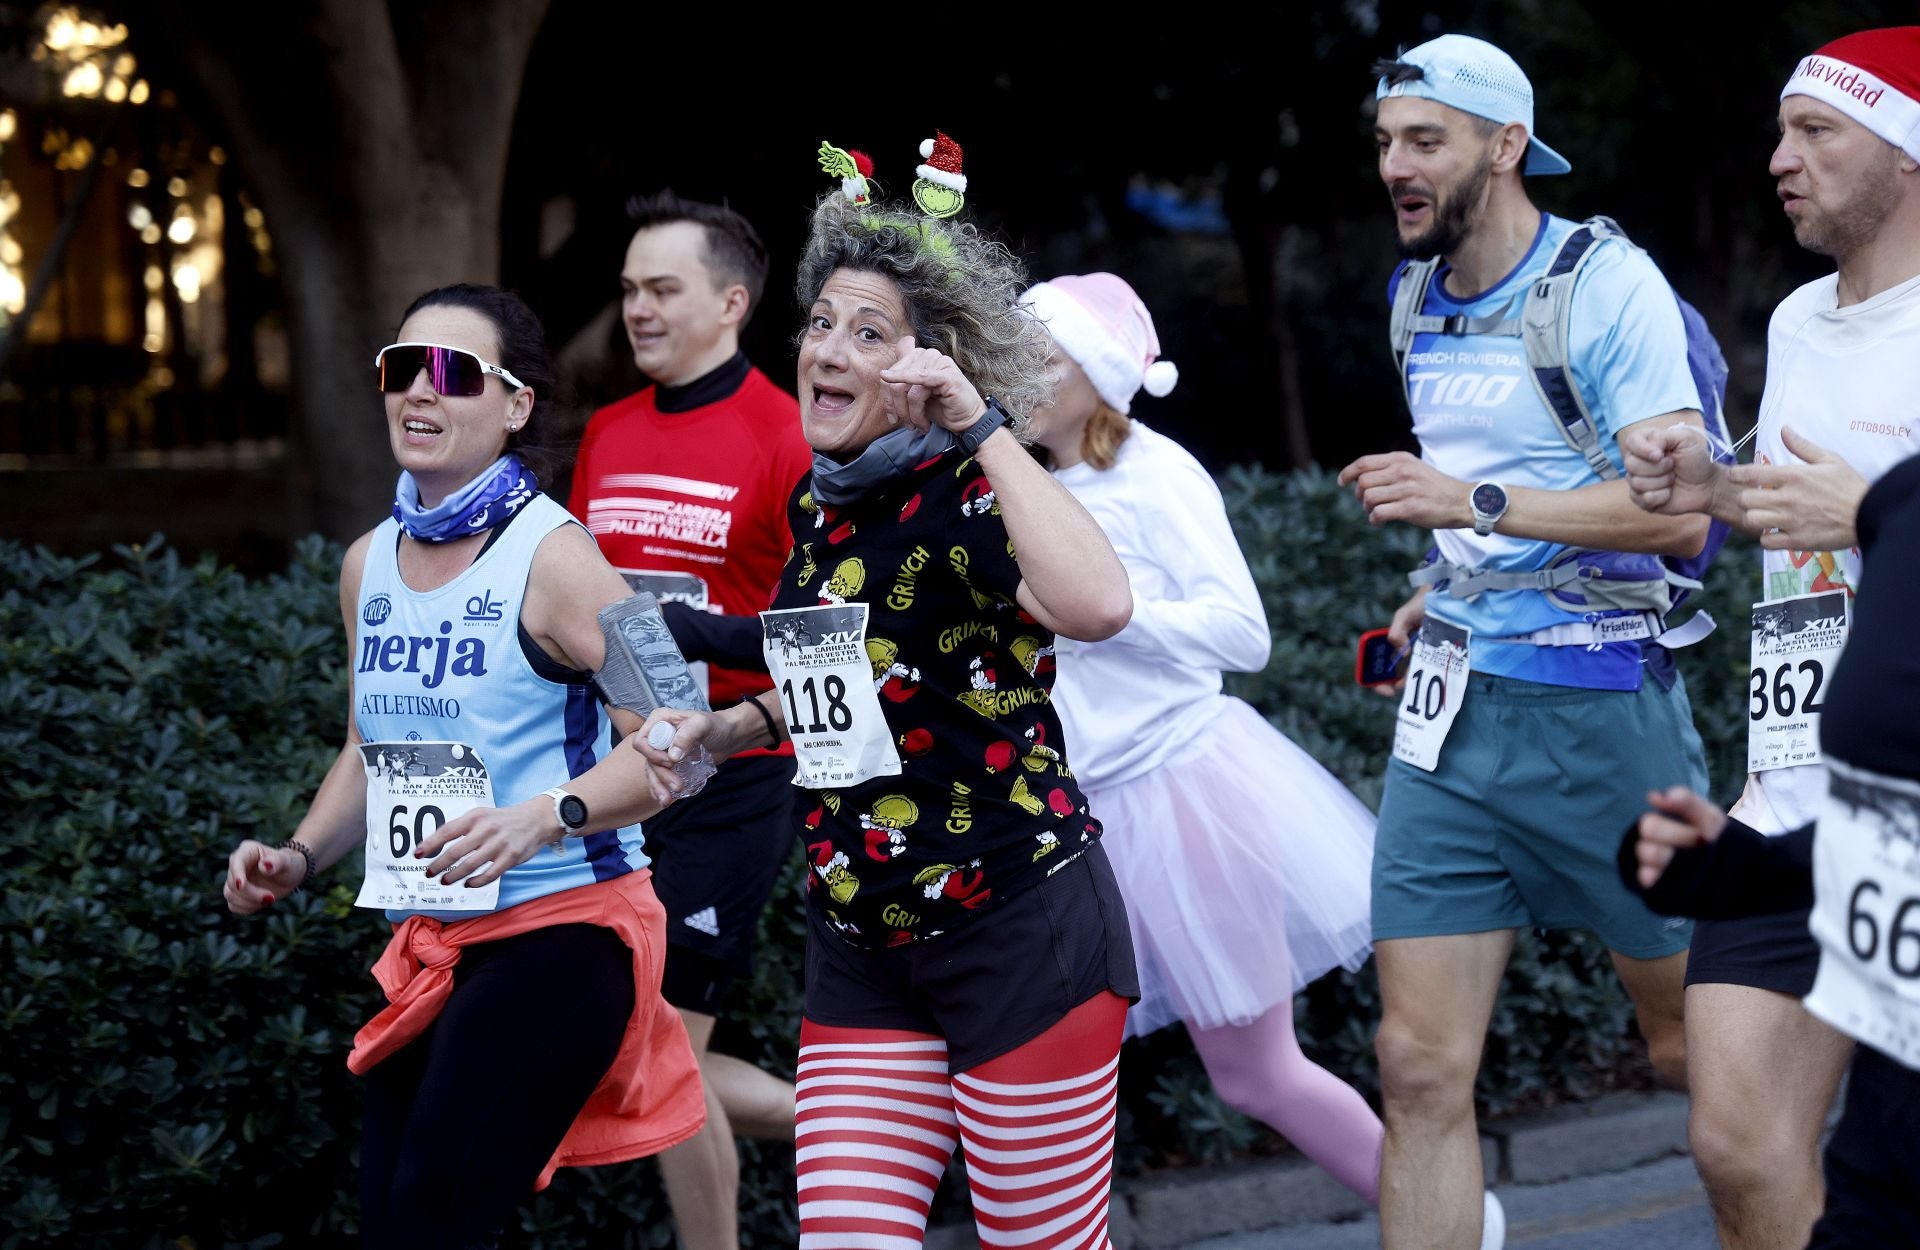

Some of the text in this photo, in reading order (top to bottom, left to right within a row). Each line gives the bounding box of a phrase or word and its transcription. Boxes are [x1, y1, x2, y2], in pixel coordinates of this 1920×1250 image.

[1801, 57, 1885, 108] Navidad
[1409, 351, 1521, 367] FRENCH RIVIERA
[1409, 371, 1521, 407] T100
[1850, 420, 1912, 437] OTTOBOSLEY
[665, 501, 732, 525] CARRERA
[609, 518, 728, 549] PALMA PALMILLA
[886, 545, 931, 611] GRINCH
[364, 599, 391, 621] TROPS
[463, 589, 503, 621] als
[1601, 619, 1643, 633] triathlon
[1794, 629, 1841, 640] CARRERA
[1801, 615, 1845, 631] XIV
[815, 643, 858, 653] CARRERA
[820, 629, 860, 645] XIV
[938, 620, 998, 654] GRINCH
[1759, 647, 1787, 656] PALMA
[1790, 640, 1842, 651] PALMILLA
[1791, 635, 1841, 645] SILVESTRE
[359, 621, 488, 689] nerja
[785, 659, 811, 667] PALMA
[813, 654, 861, 665] PALMILLA
[814, 649, 859, 659] SILVESTRE
[1406, 669, 1445, 720] 10
[1751, 659, 1823, 721] 362
[361, 693, 460, 719] ATLETISMO
[782, 674, 852, 734] 118
[440, 766, 485, 778] XIV
[389, 804, 446, 859] 60
[1848, 878, 1920, 980] 66
